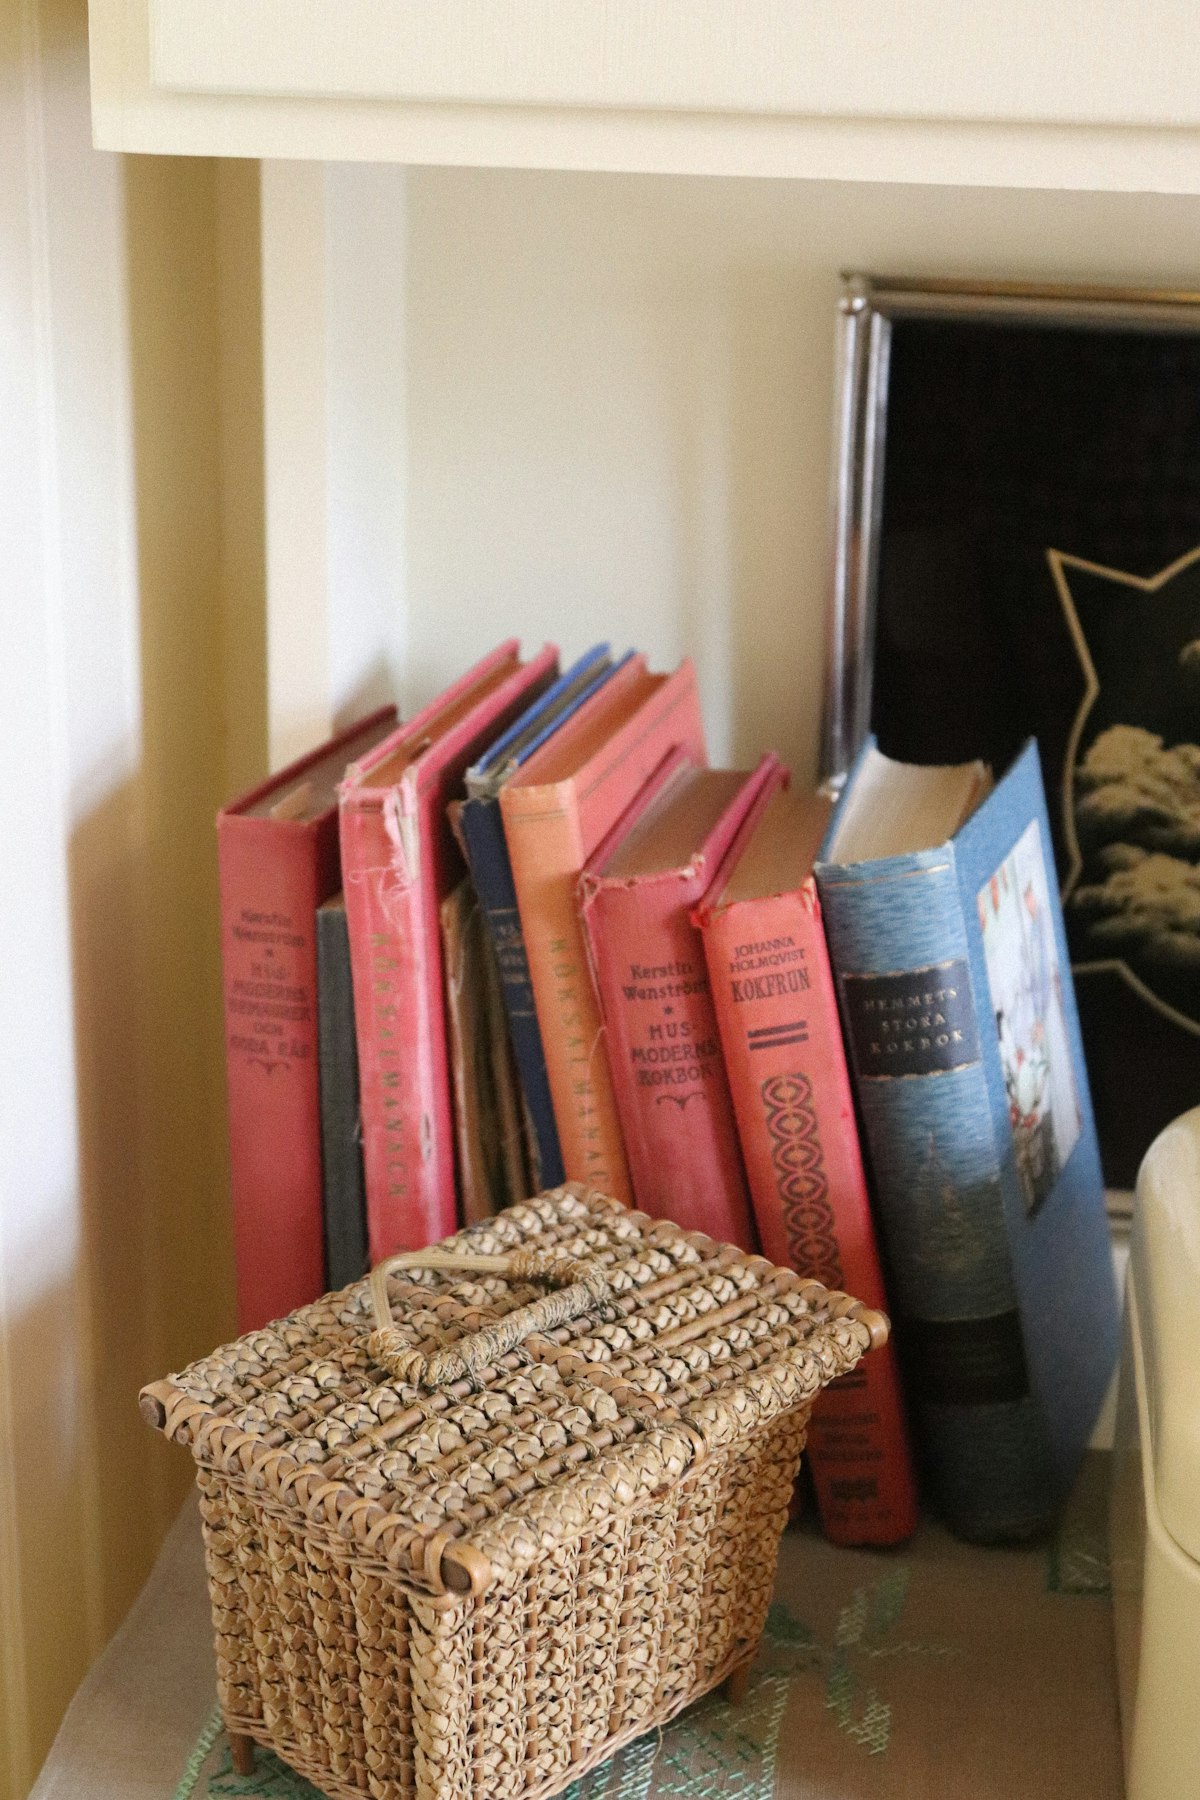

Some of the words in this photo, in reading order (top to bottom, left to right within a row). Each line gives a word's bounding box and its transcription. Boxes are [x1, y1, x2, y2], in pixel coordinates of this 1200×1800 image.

[735, 936, 796, 960] JOHANNA
[630, 960, 694, 981] Kerstin
[730, 948, 805, 973] HOLMQVIST
[731, 967, 811, 1003] KOKFRUN
[864, 988, 957, 1010] HEMMETS
[882, 1012, 946, 1032] STORA
[870, 1029, 963, 1054] KOKBOK
[636, 1063, 713, 1087] KOKBOK
